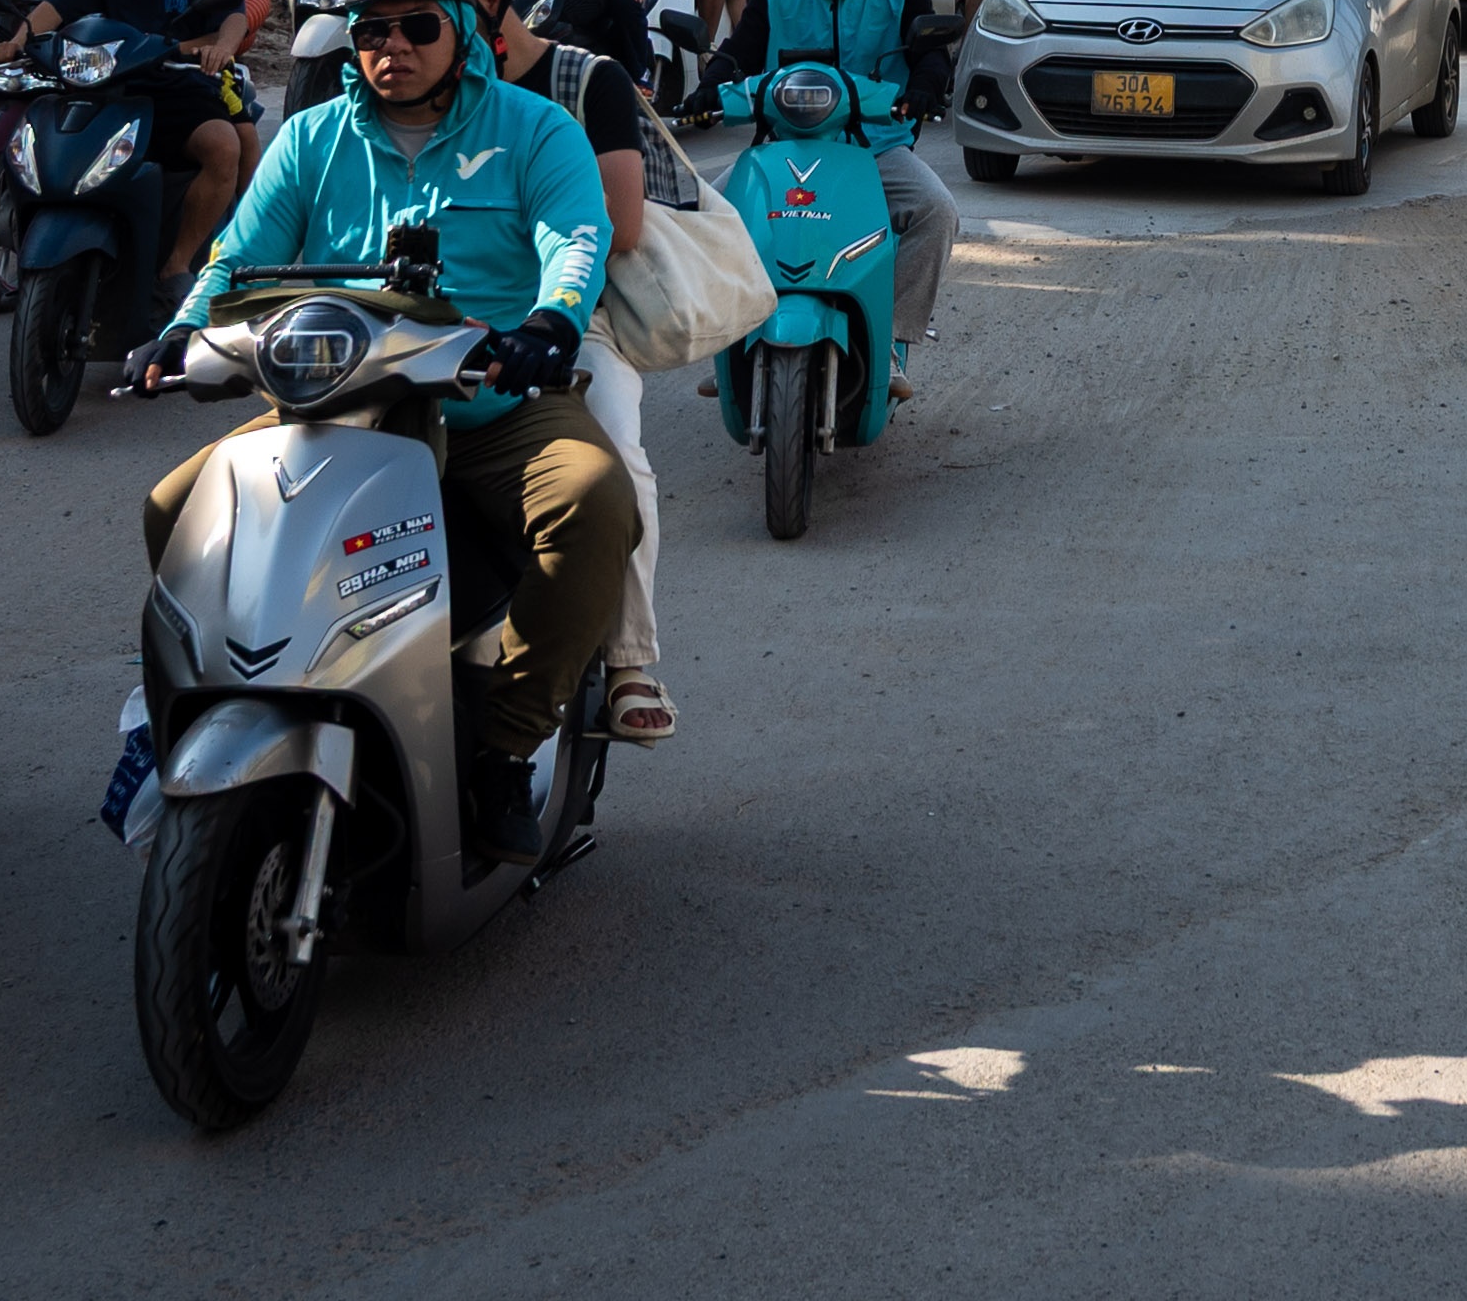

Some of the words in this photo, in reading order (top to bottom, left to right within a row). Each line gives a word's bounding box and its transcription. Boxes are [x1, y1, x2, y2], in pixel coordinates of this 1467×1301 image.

[1116, 75, 1150, 94] 30A
[781, 210, 831, 221] VIETNAM
[372, 523, 402, 539] VIET
[406, 514, 433, 529] NAM
[339, 574, 363, 597] 29
[363, 565, 389, 581] HA
[395, 550, 426, 568] NOI
